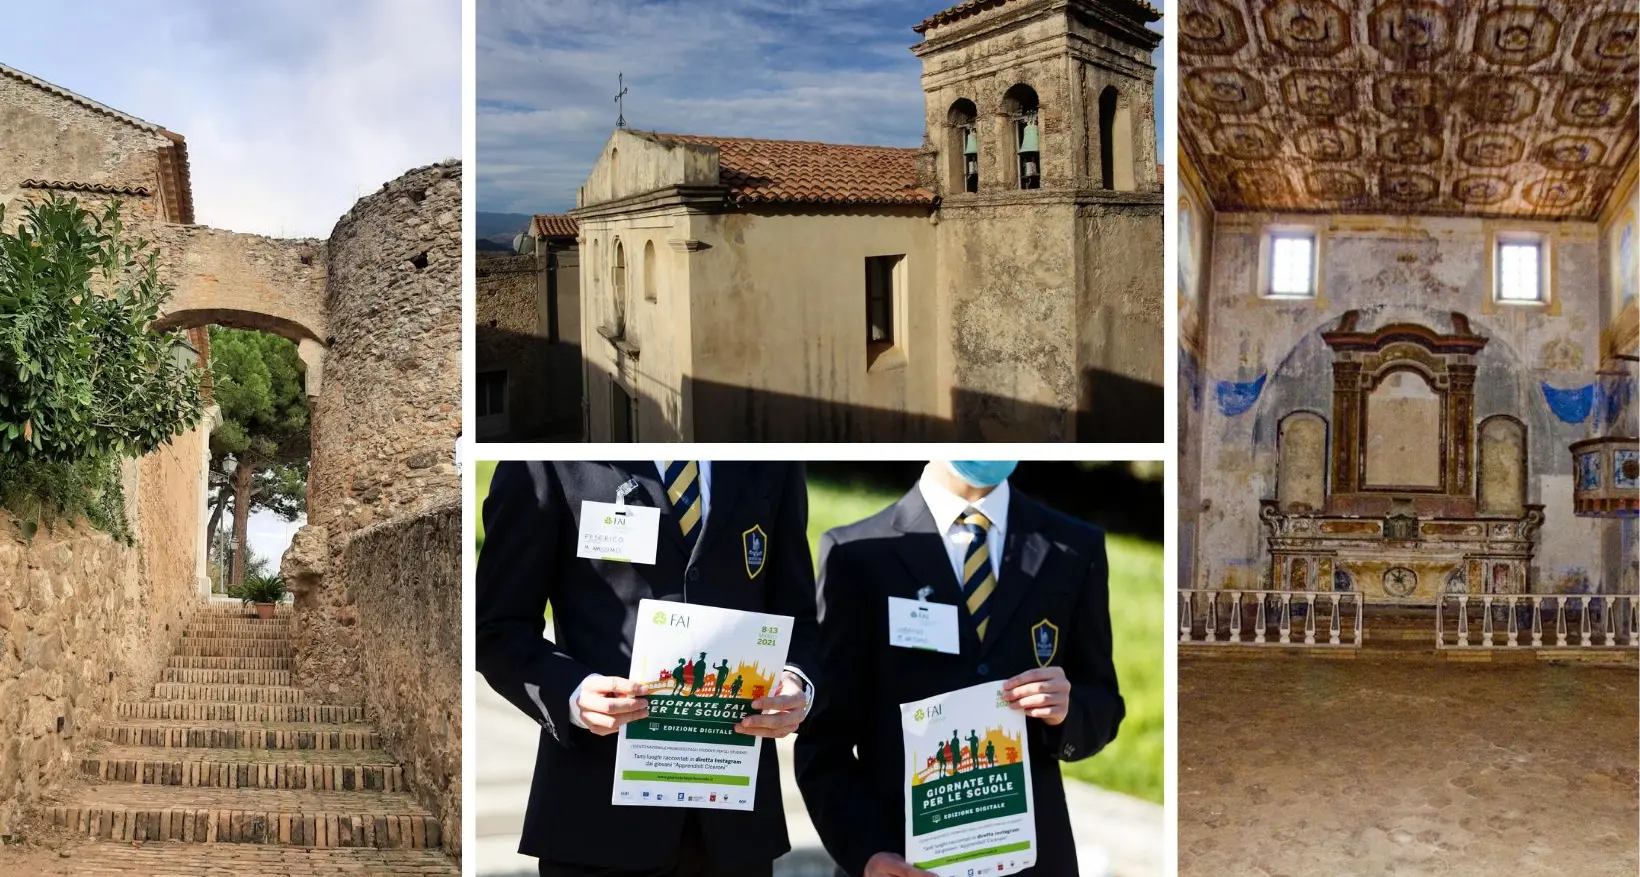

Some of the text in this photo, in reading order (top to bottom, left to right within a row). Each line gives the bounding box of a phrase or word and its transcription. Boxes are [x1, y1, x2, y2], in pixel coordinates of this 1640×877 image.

[614, 517, 626, 526] FAI
[670, 613, 690, 628] FAI
[757, 638, 776, 646] 2021
[650, 699, 746, 711] GIORNATE FAI
[926, 703, 942, 718] FAI
[673, 706, 689, 716] LE
[694, 708, 748, 720] SCUOLE
[663, 724, 733, 736] EDIZIONE DIGITALE
[926, 772, 1008, 798] GIORNATE FAI
[922, 781, 1014, 810] PER LE SCUOLE
[943, 802, 1006, 820] EDIZIONE DIGITALE
